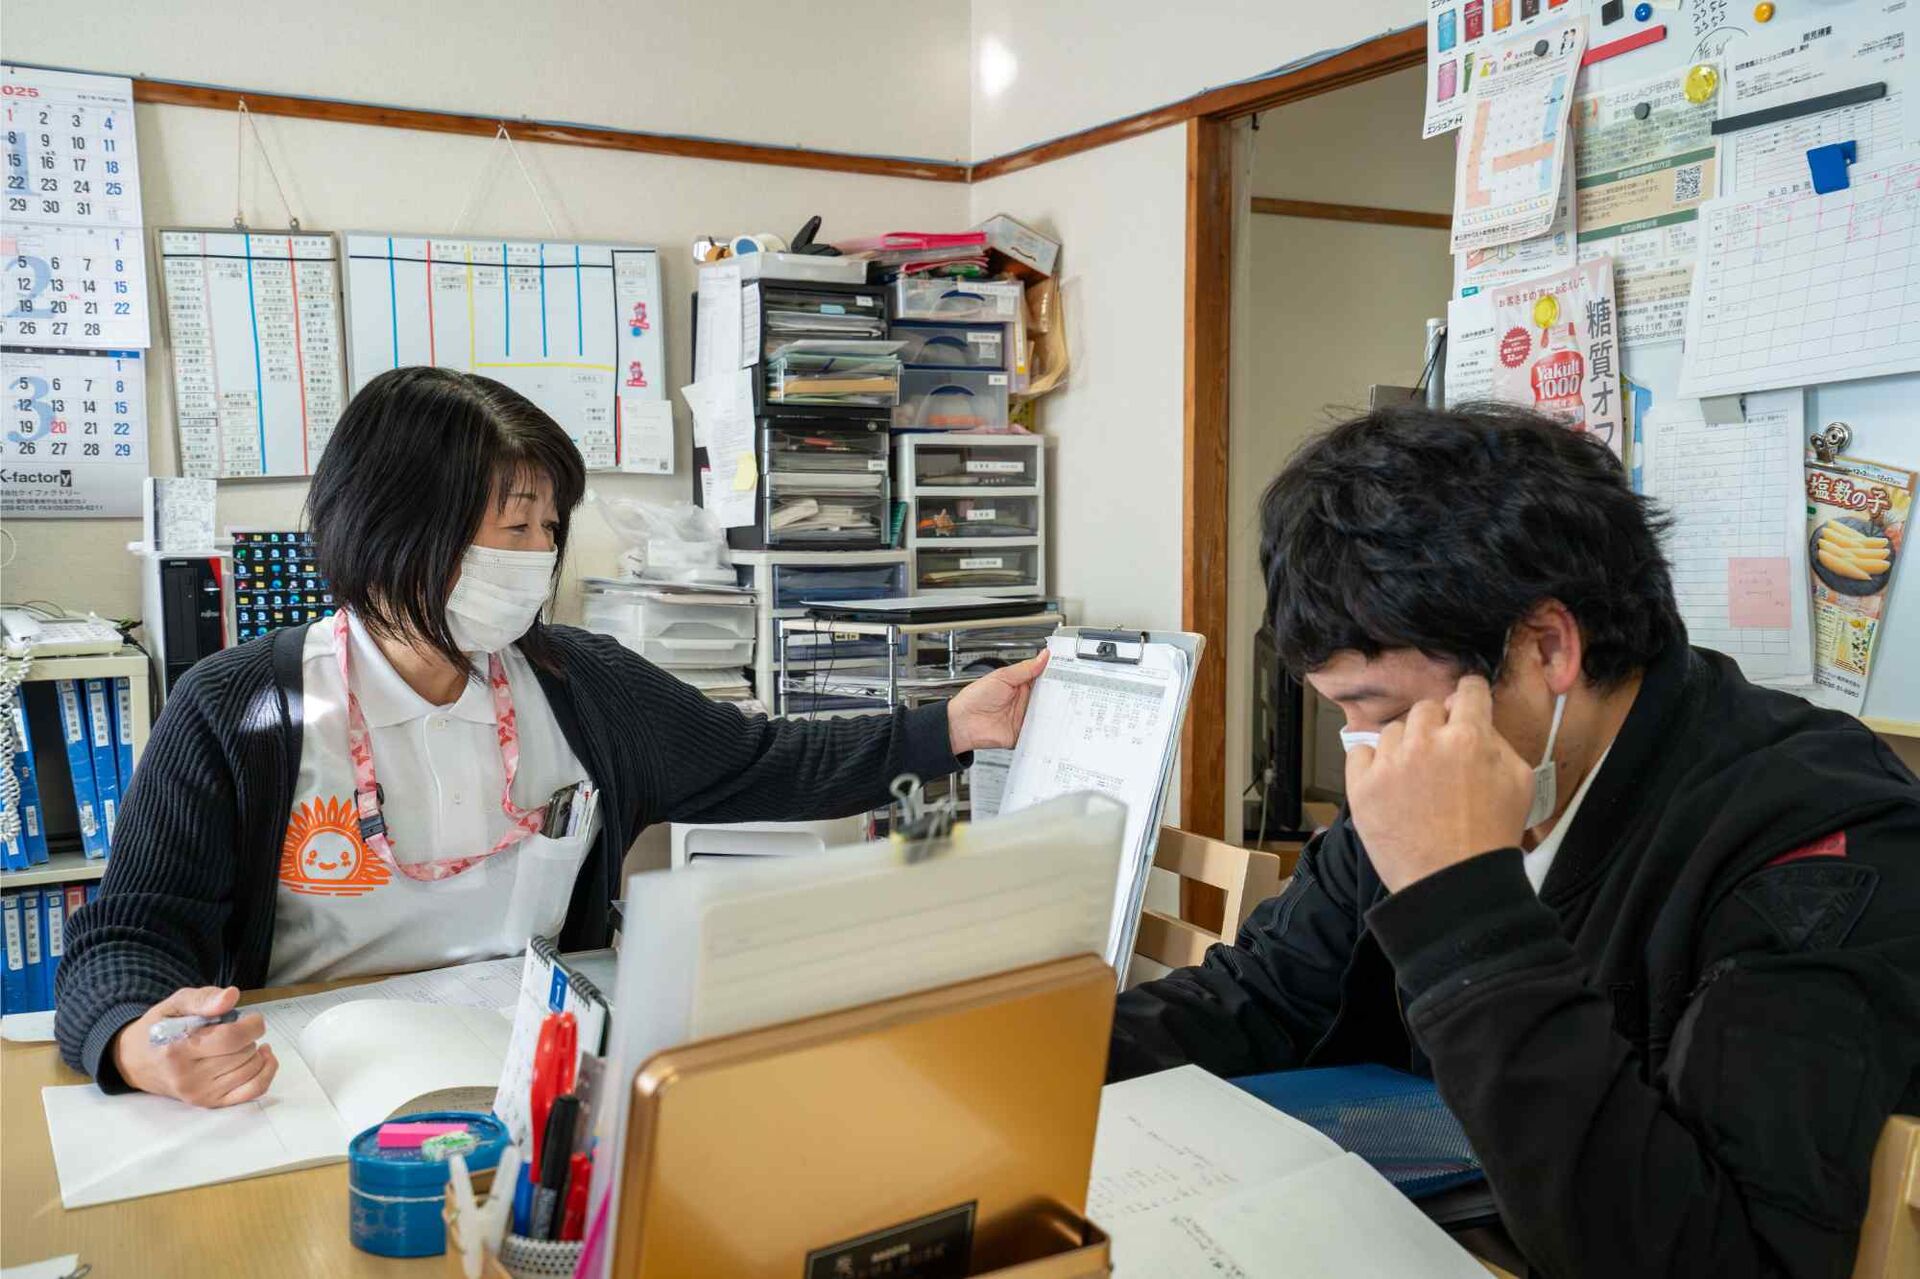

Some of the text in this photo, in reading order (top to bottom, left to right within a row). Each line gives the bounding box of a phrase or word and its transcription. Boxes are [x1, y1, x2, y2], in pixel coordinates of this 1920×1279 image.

[8, 109, 113, 130] 1 2 3 4
[8, 131, 115, 152] 8 9 10 11
[8, 154, 119, 174] 15 16 17 18
[8, 176, 122, 195] 22 23 24 25
[10, 198, 91, 215] 29 30 31
[115, 238, 119, 251] 1
[18, 256, 124, 272] 5 6 7 8
[18, 278, 128, 294] 12 13 14 15
[19, 300, 130, 315] 19 20 21 22
[19, 321, 101, 336] 26 27 28
[117, 360, 121, 371] 1
[1537, 360, 1580, 381] Yakult
[1586, 296, 1615, 448] 糖質オフ
[19, 377, 124, 393] 5 6 7 8
[1536, 375, 1579, 400] 1000
[18, 399, 127, 414] 12 13 14 15
[19, 420, 130, 435] 19 20 21 22
[19, 442, 130, 456] 26 27 28 29
[0, 469, 71, 487] K-factory
[1809, 475, 1889, 516] 塩数の子
